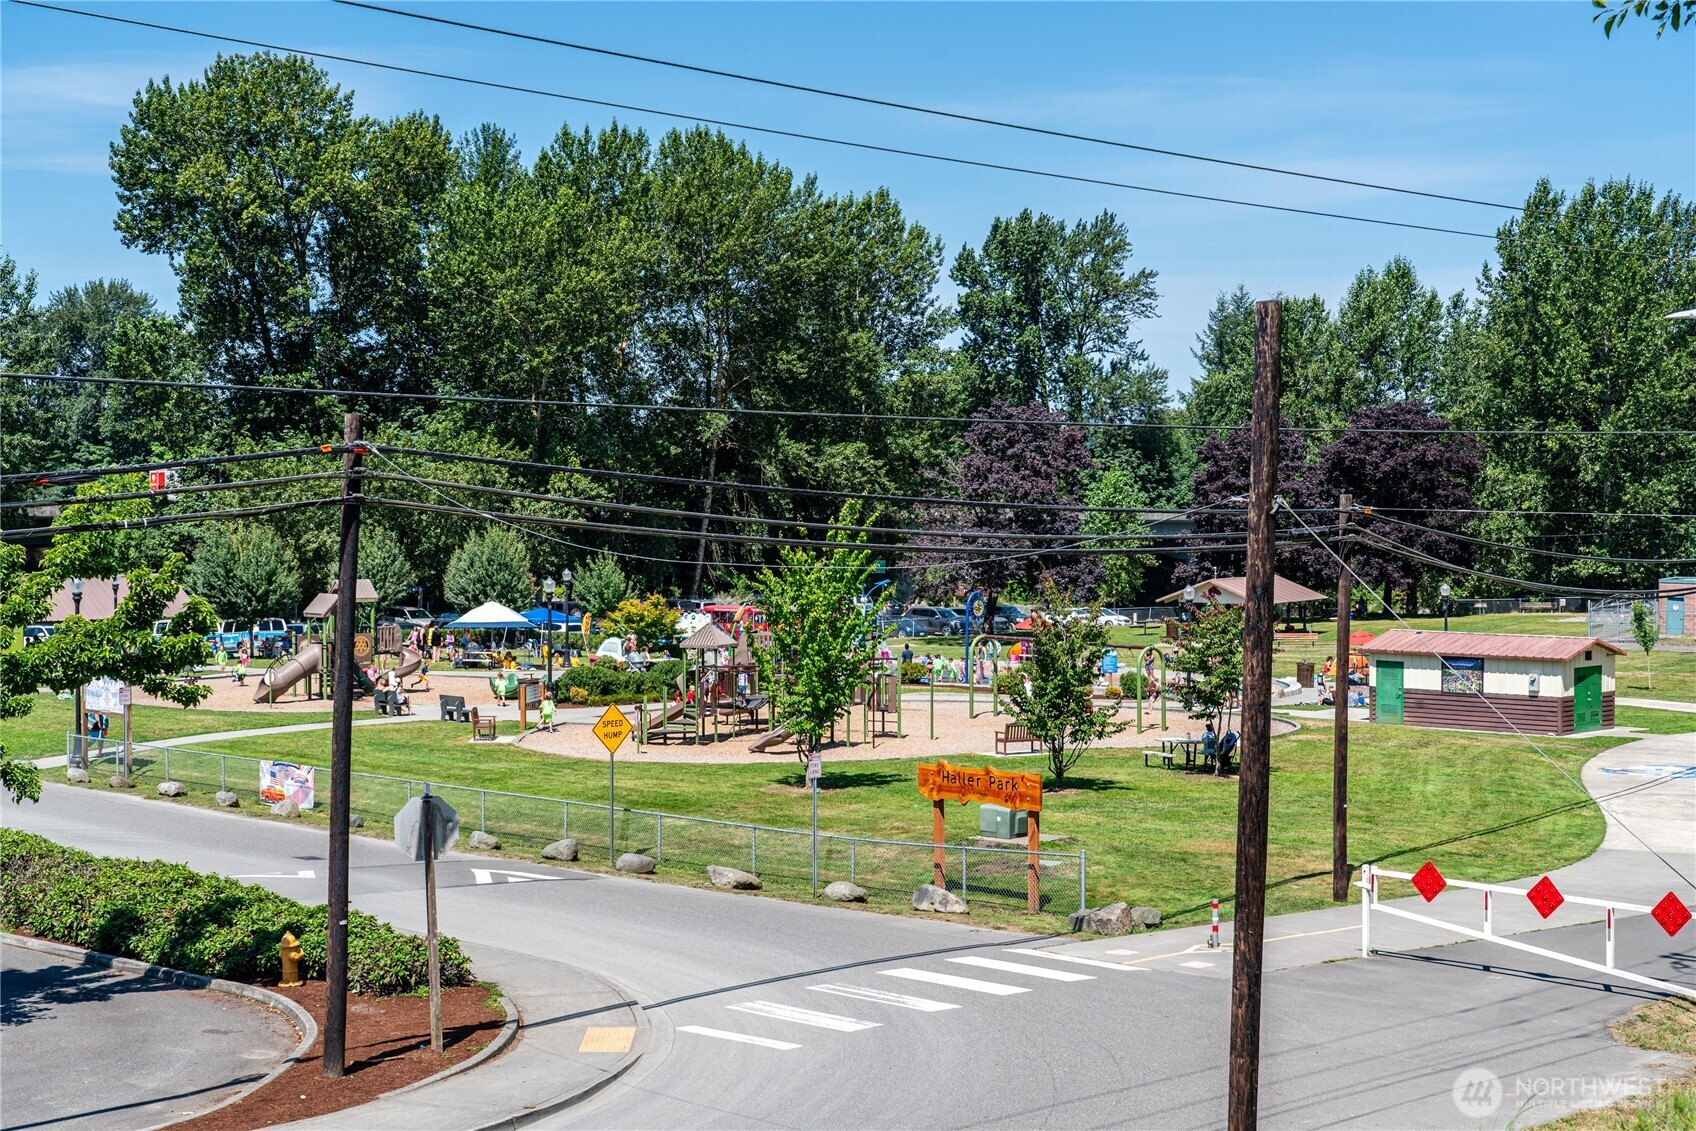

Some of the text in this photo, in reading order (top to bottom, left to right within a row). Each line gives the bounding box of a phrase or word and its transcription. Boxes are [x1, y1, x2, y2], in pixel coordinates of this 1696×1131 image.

[602, 719, 623, 728] SPEED
[603, 730, 623, 740] HUMP
[941, 769, 1018, 791] Haller Park
